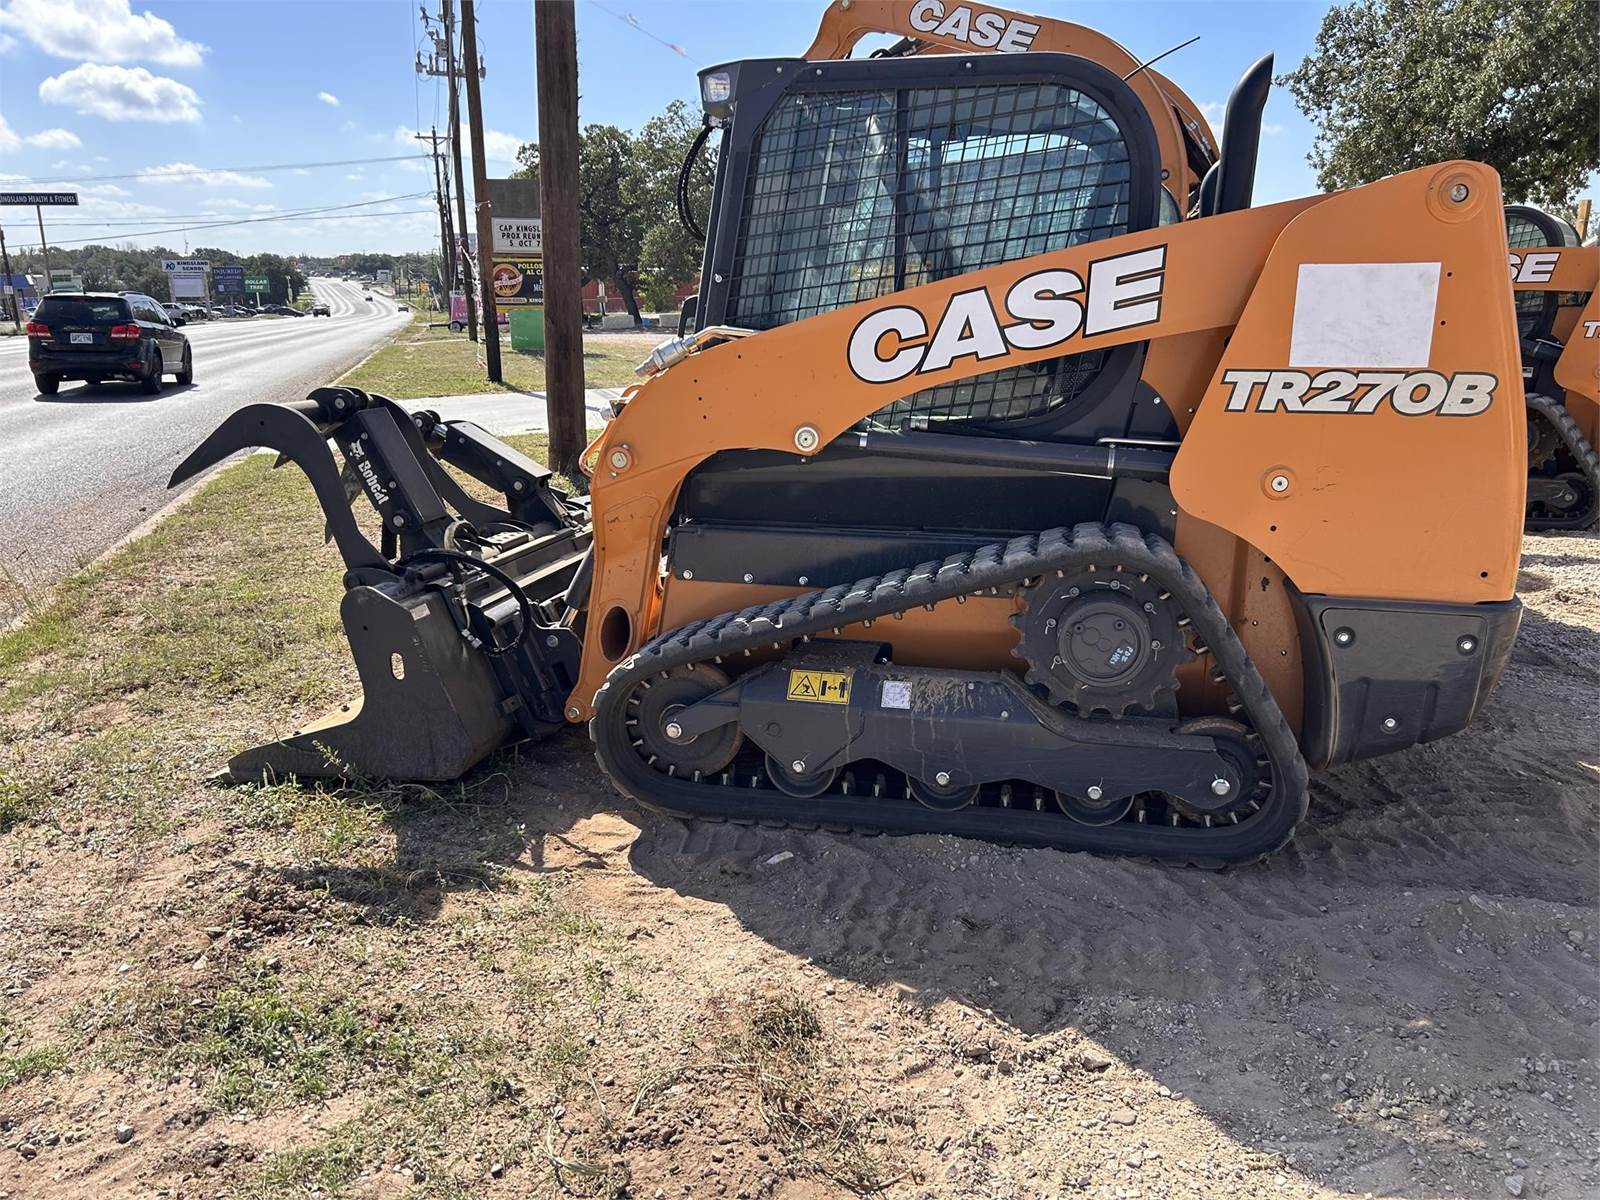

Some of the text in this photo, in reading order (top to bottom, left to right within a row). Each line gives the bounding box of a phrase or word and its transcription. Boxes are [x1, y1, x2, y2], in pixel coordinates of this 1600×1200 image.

[909, 0, 1041, 53] CASE
[0, 195, 28, 203] INGSLAND
[49, 195, 54, 203] &
[54, 195, 76, 203] FITNESS
[501, 232, 520, 240] PROX
[848, 244, 1168, 384] CASE
[1221, 369, 1500, 417] TR270B
[357, 460, 390, 505] Bobcat
